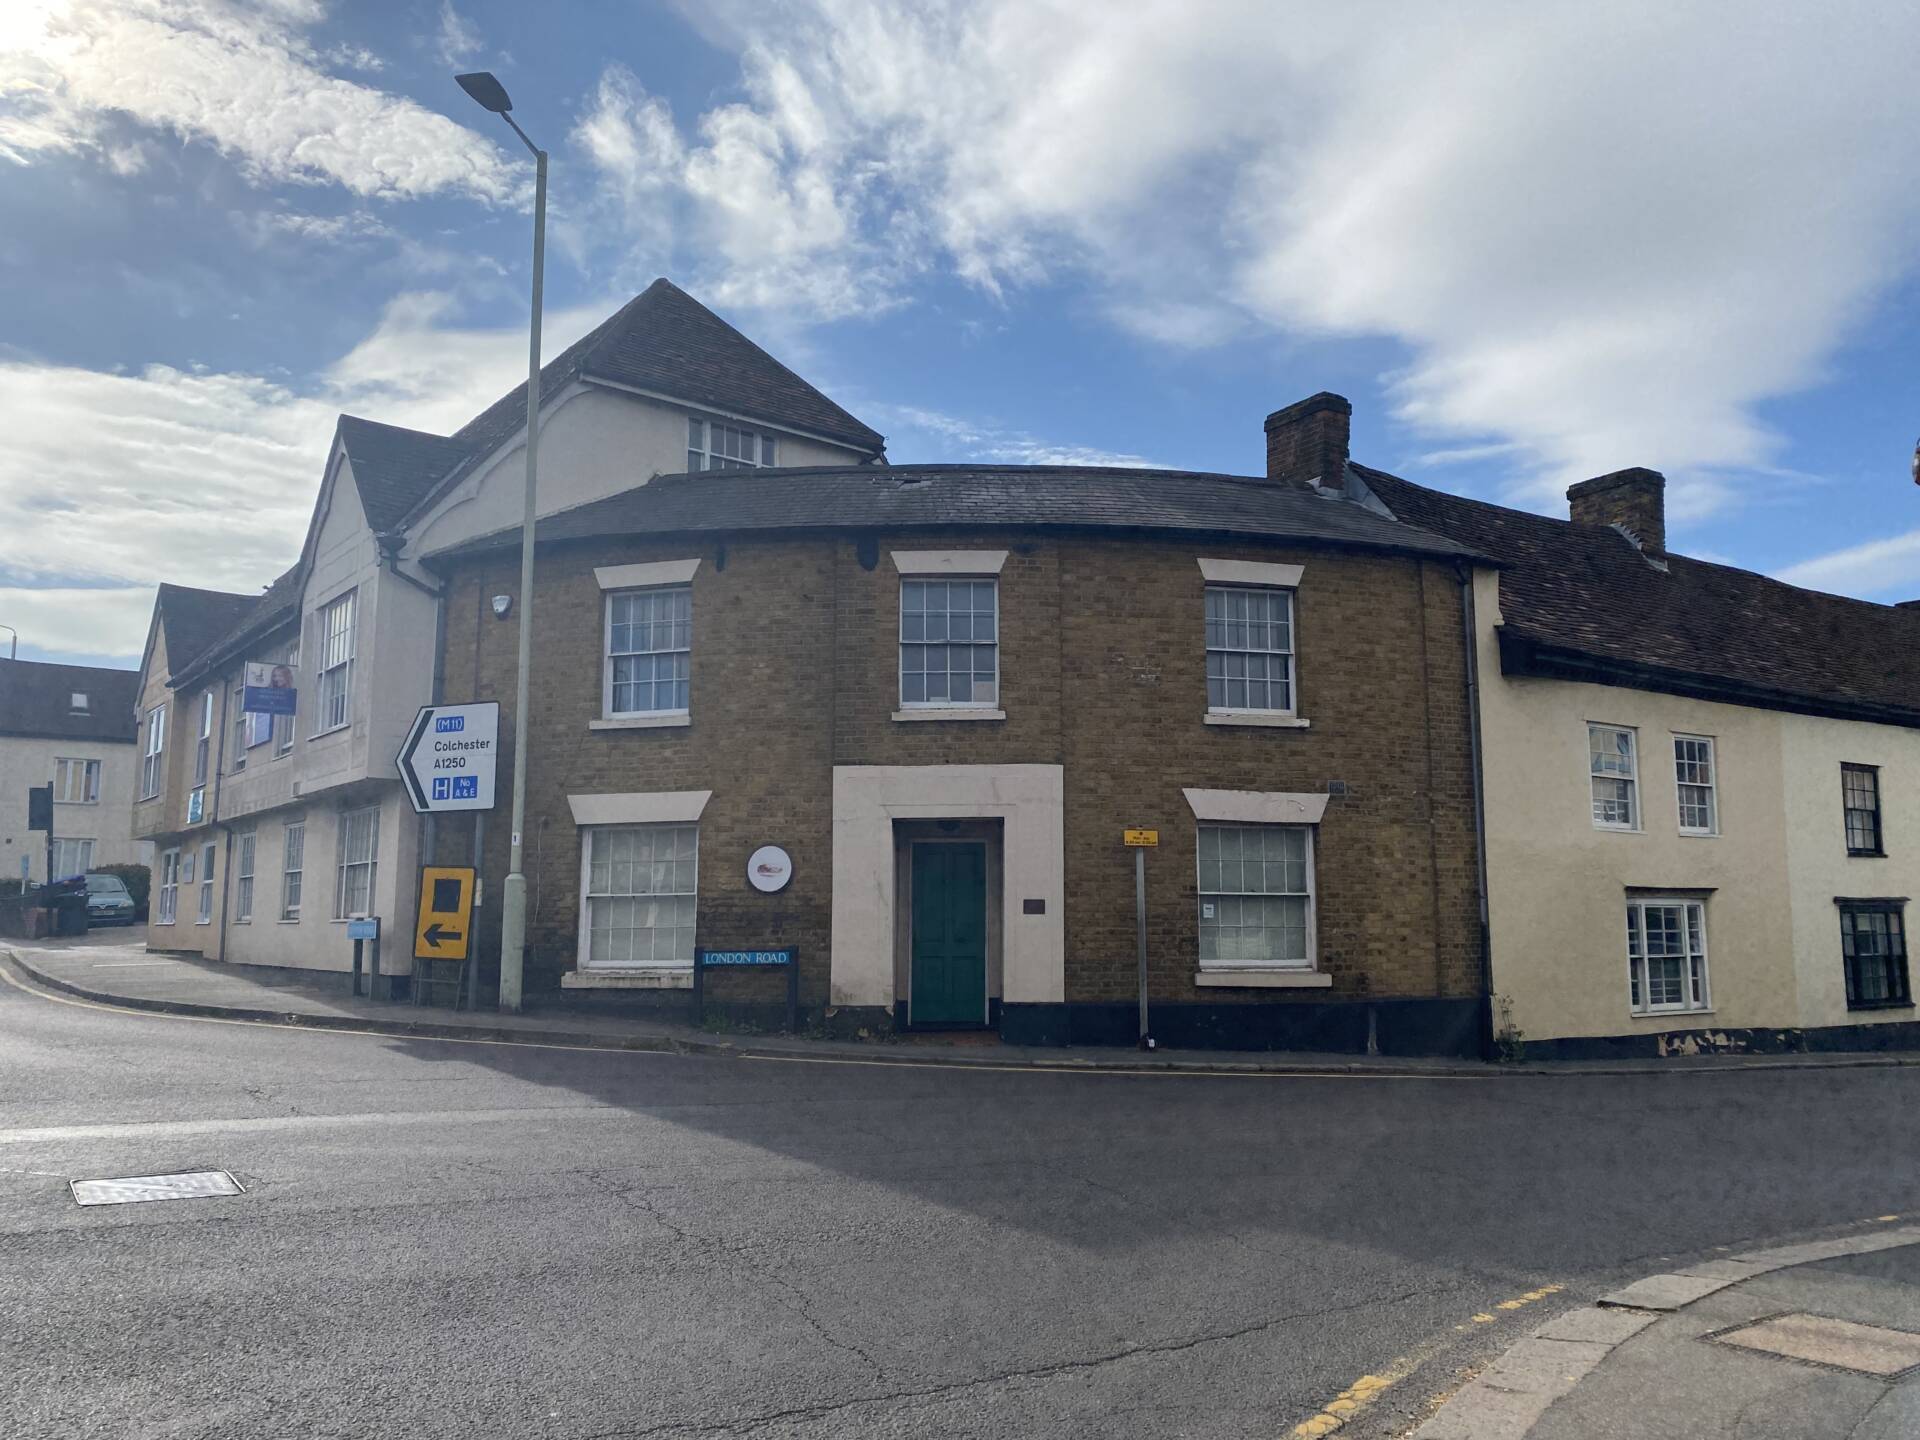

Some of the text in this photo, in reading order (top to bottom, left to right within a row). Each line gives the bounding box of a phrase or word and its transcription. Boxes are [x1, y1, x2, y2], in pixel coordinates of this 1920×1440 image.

[437, 718, 463, 731] (M11)
[434, 739, 491, 752] Colchester
[434, 757, 466, 769] A1250
[460, 778, 471, 787] No
[435, 779, 448, 799] H
[705, 952, 787, 964] LONDON ROAD
